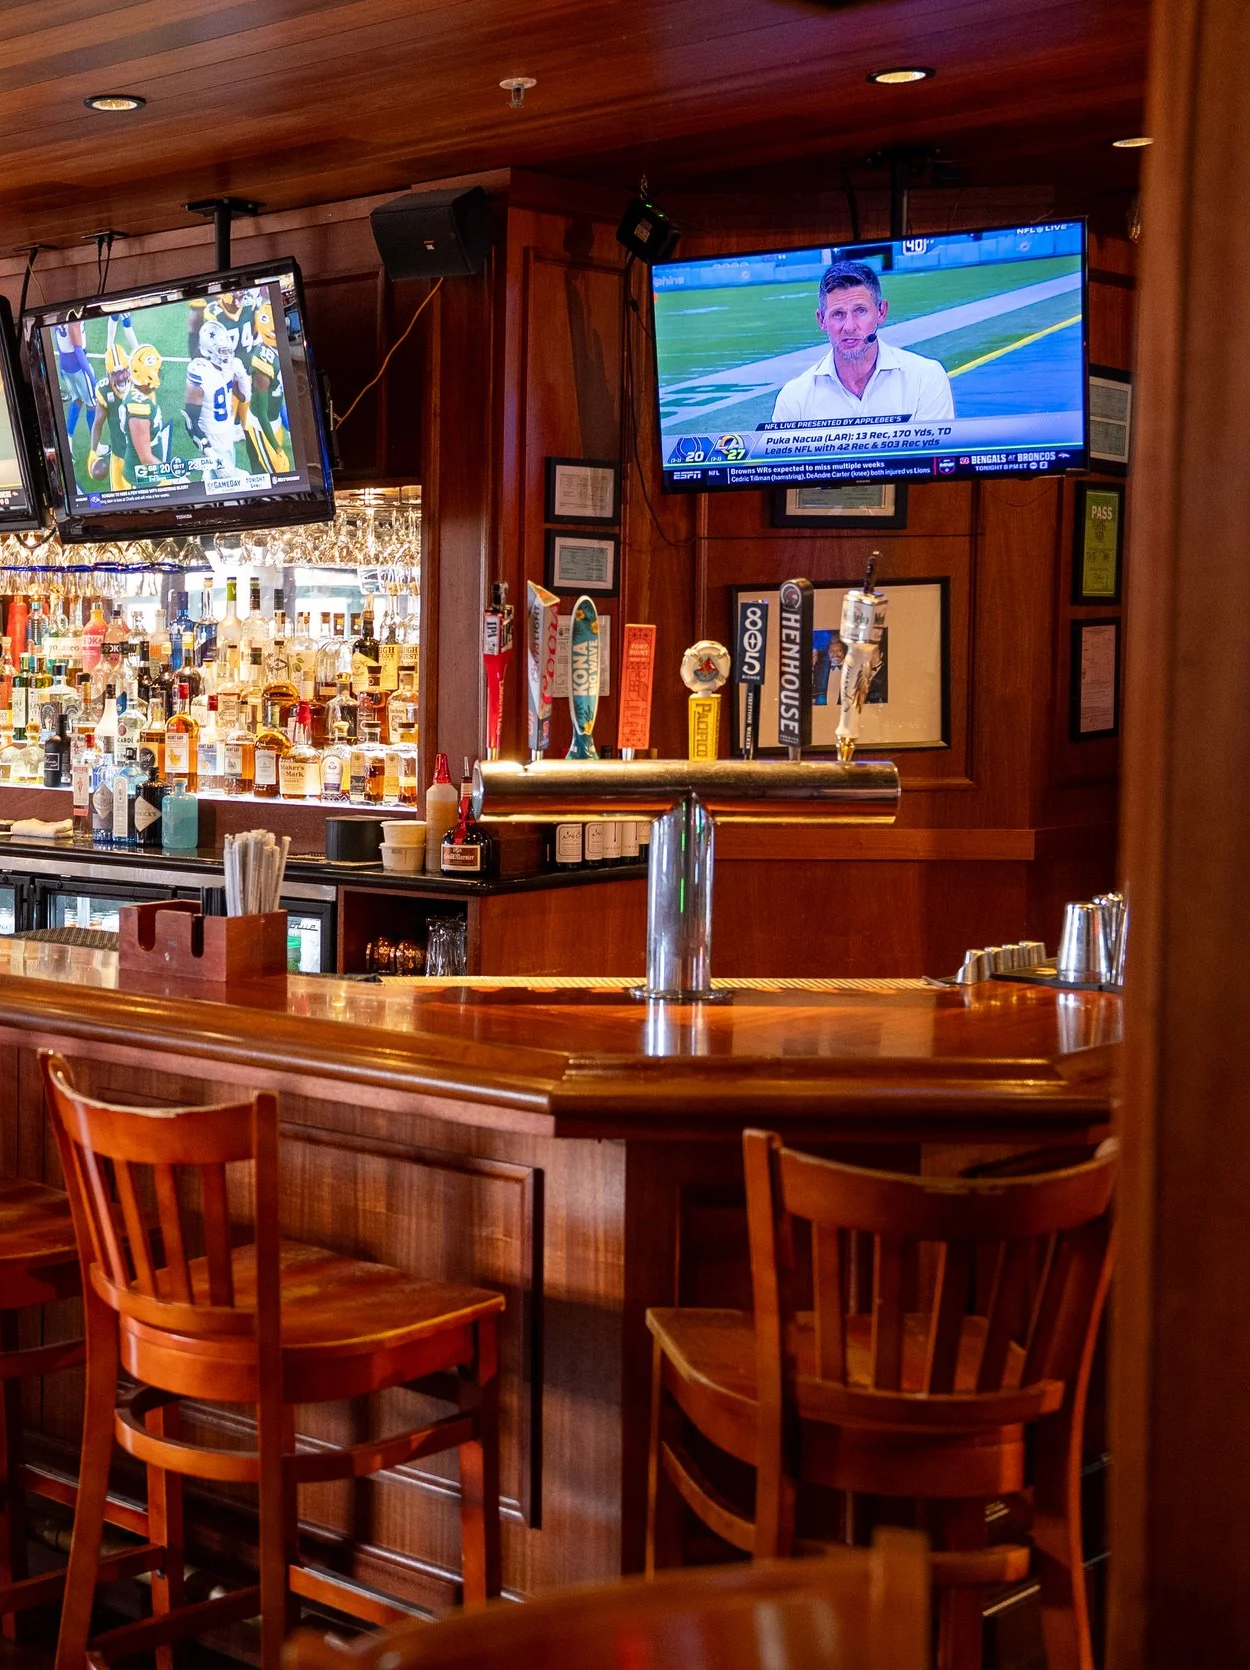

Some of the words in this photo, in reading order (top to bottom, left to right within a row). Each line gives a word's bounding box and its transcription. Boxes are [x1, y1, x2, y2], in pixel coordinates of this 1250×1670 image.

[1016, 226, 1036, 235] NFL
[1044, 224, 1067, 233] LIVE
[779, 422, 796, 430] LIVE
[798, 419, 842, 429] PRESENTED
[843, 418, 853, 426] BY
[854, 415, 902, 425] APPLEBEE'S
[766, 437, 790, 446] Puka
[792, 435, 822, 444] Nacua
[824, 432, 854, 443] (LAR):
[855, 432, 867, 440] 13
[869, 431, 891, 440] Rec,
[893, 429, 911, 438] 170
[914, 428, 934, 438] Yds,
[937, 427, 951, 436] TD
[727, 449, 746, 460] 27
[765, 447, 792, 456] Leads
[794, 446, 813, 454] NFL
[814, 444, 835, 452] with
[837, 443, 849, 451] 42
[851, 442, 869, 450] Rec
[872, 441, 879, 449] &
[880, 441, 900, 449] 503
[902, 439, 920, 447] Rec
[922, 438, 940, 448] yds
[685, 451, 704, 462] 20
[971, 454, 1006, 464] BENGALS
[1017, 452, 1056, 462] BRONCOS
[160, 464, 170, 473] 20
[188, 461, 198, 470] 23
[731, 475, 749, 483] Cedric
[806, 471, 831, 479] DeAndre
[832, 470, 850, 478] Carter
[850, 469, 870, 478] (knee)
[870, 468, 884, 476] both
[885, 467, 905, 477] injured
[913, 466, 930, 474] Lions
[773, 465, 805, 475] expected
[814, 463, 831, 471] miss
[832, 462, 861, 471] multiple
[673, 471, 701, 480] ESPN
[1091, 505, 1113, 520] PASS
[486, 621, 498, 638] IPA
[533, 605, 541, 641] LIGHT
[742, 607, 763, 675] 805
[589, 639, 598, 678] WAVE
[572, 640, 589, 696] KONA
[780, 609, 800, 735] HENHOUSE
[280, 763, 305, 771] Maker's
